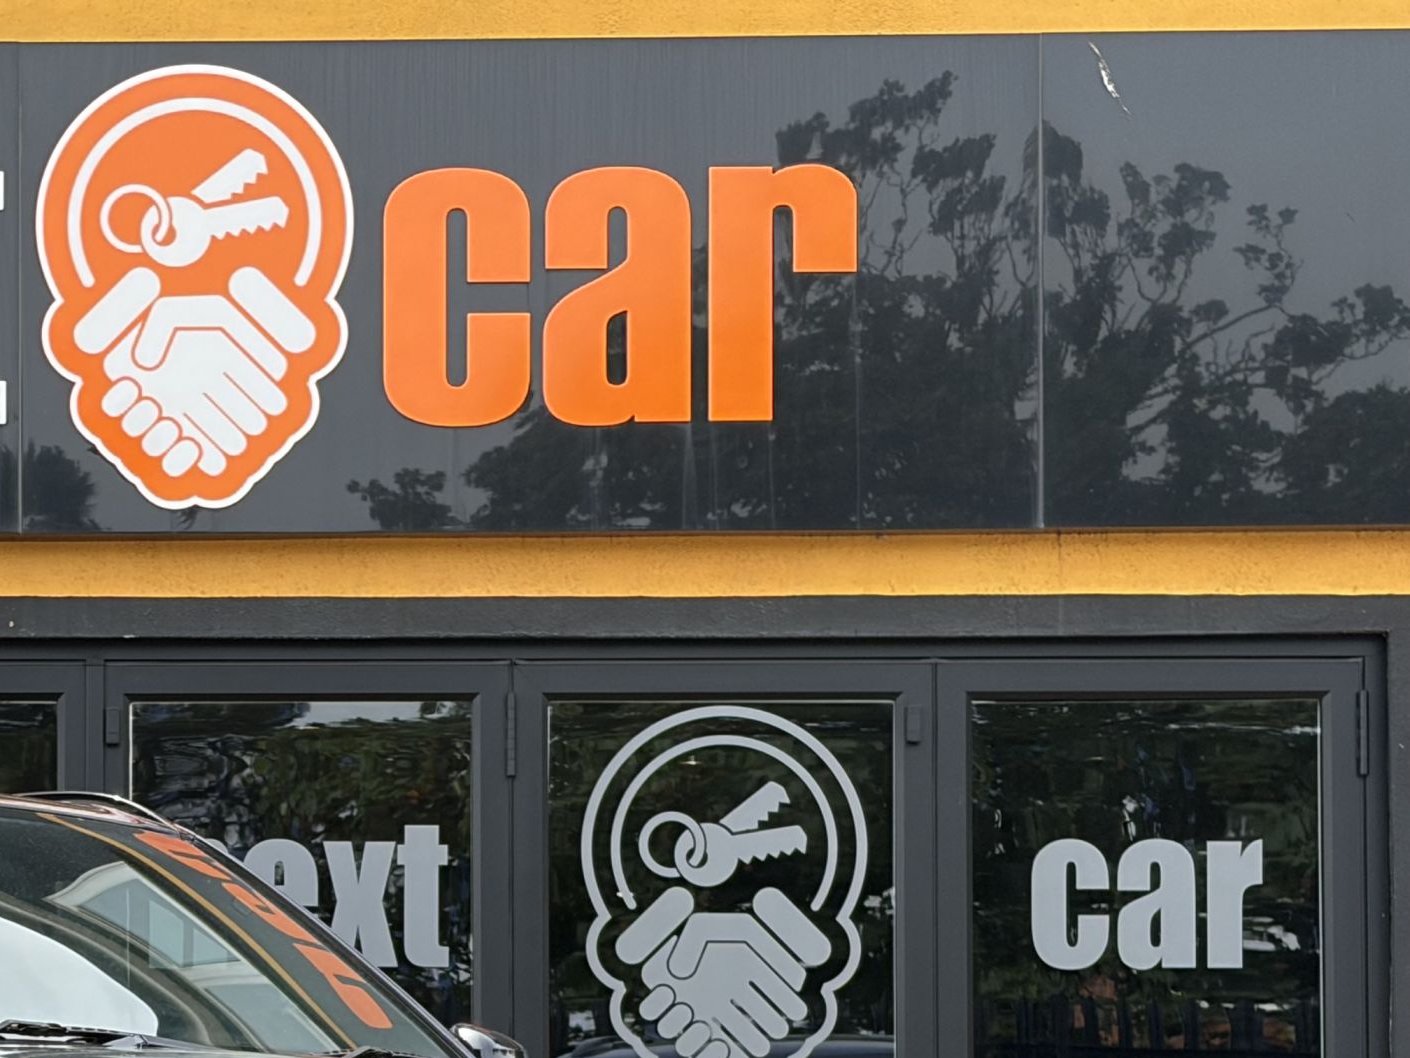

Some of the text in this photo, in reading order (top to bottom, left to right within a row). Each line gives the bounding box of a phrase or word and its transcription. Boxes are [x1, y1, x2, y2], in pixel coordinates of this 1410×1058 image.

[382, 162, 858, 428] car
[202, 824, 1264, 971] ext car
